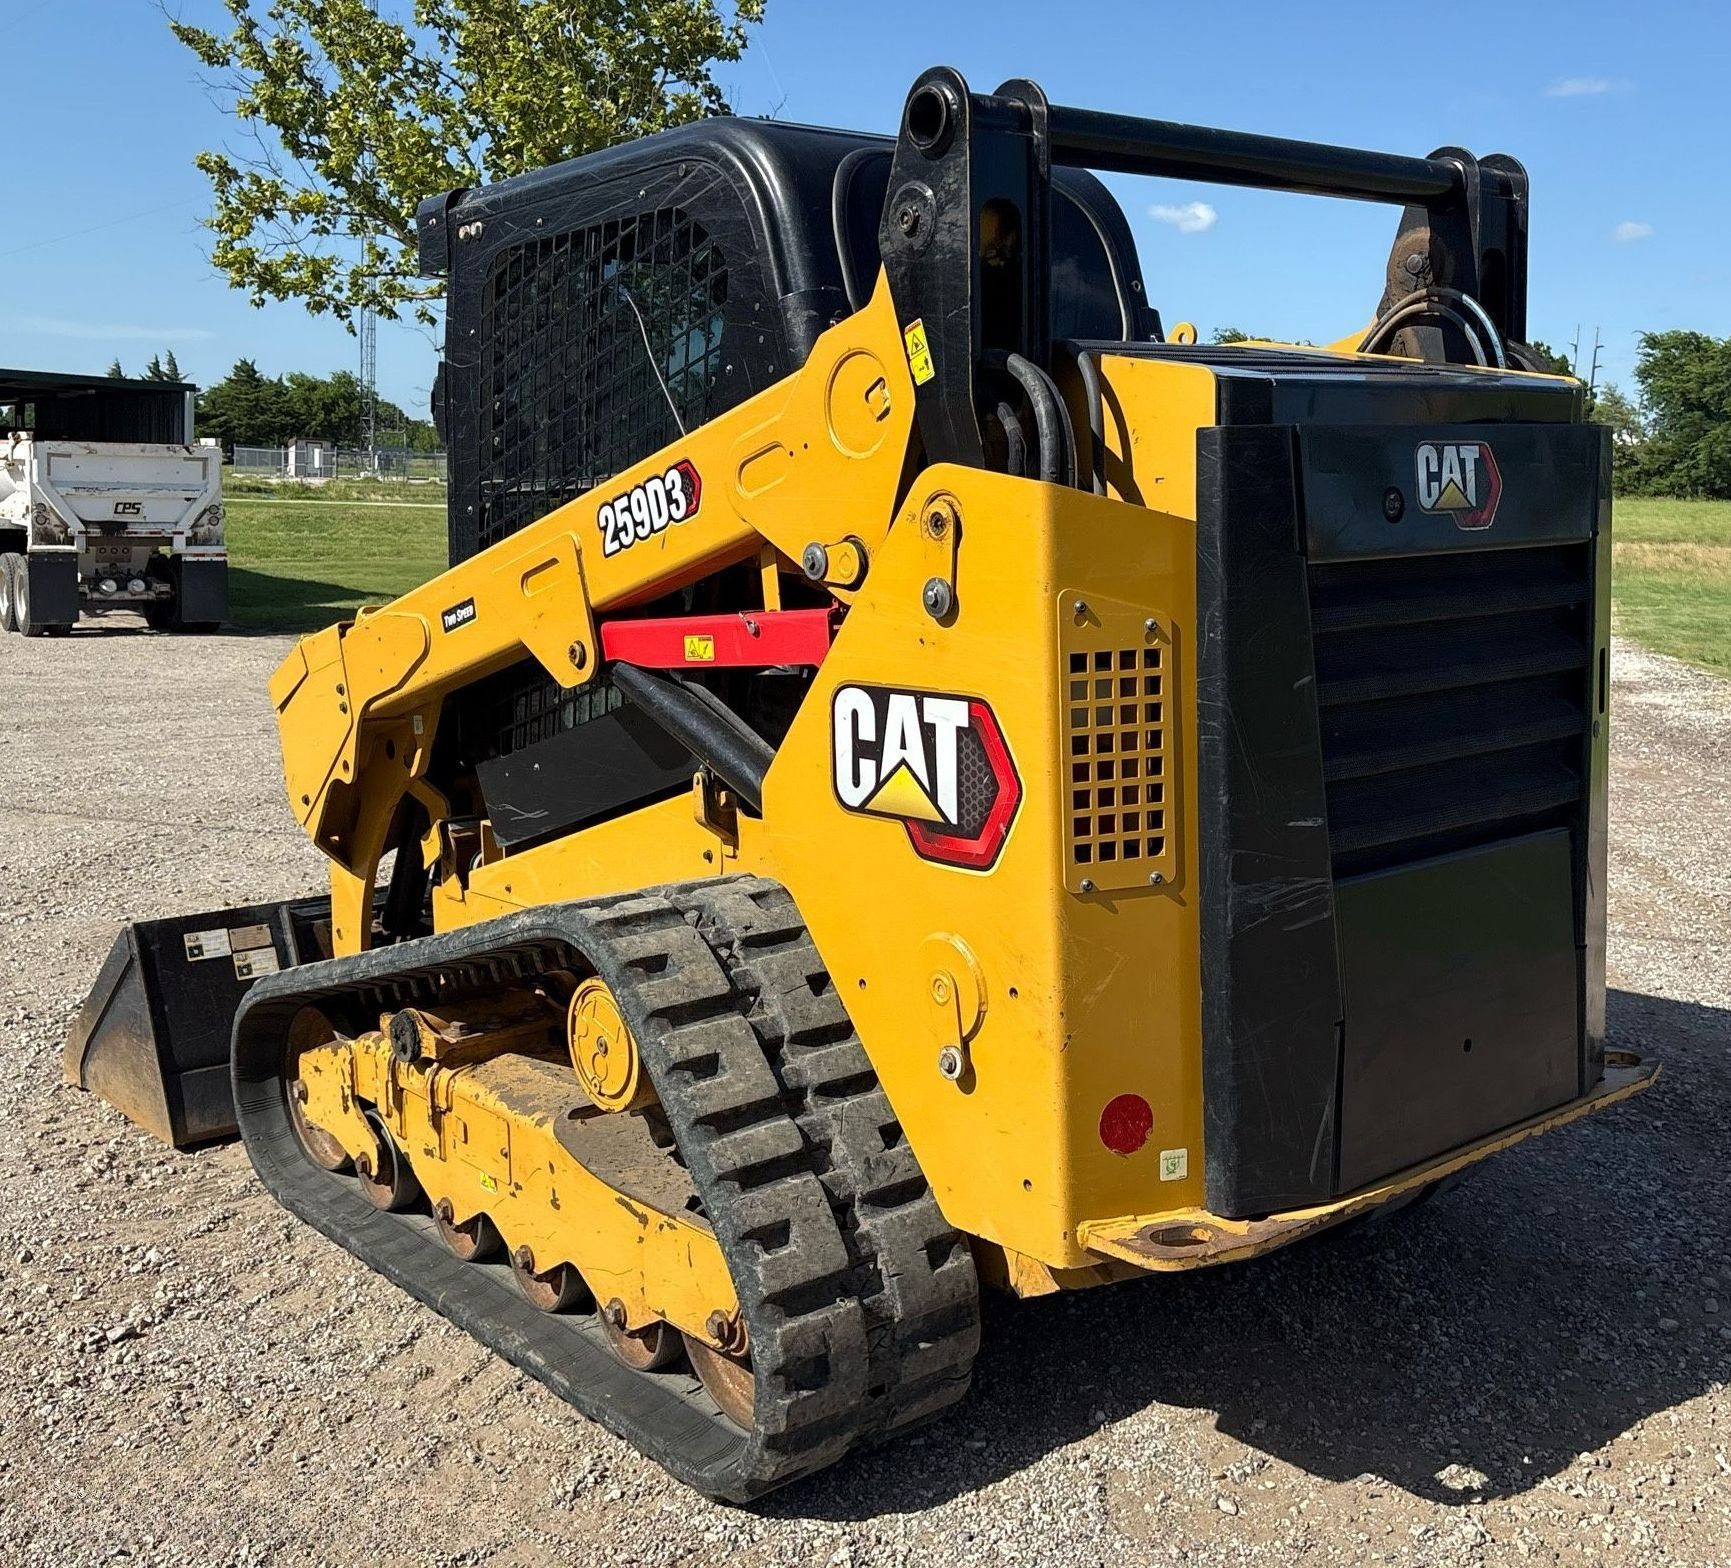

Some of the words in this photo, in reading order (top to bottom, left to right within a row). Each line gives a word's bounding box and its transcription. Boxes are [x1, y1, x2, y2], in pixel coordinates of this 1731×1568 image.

[599, 468, 687, 556] 259D3
[1417, 444, 1480, 509] CAT
[834, 687, 970, 825] CAT
